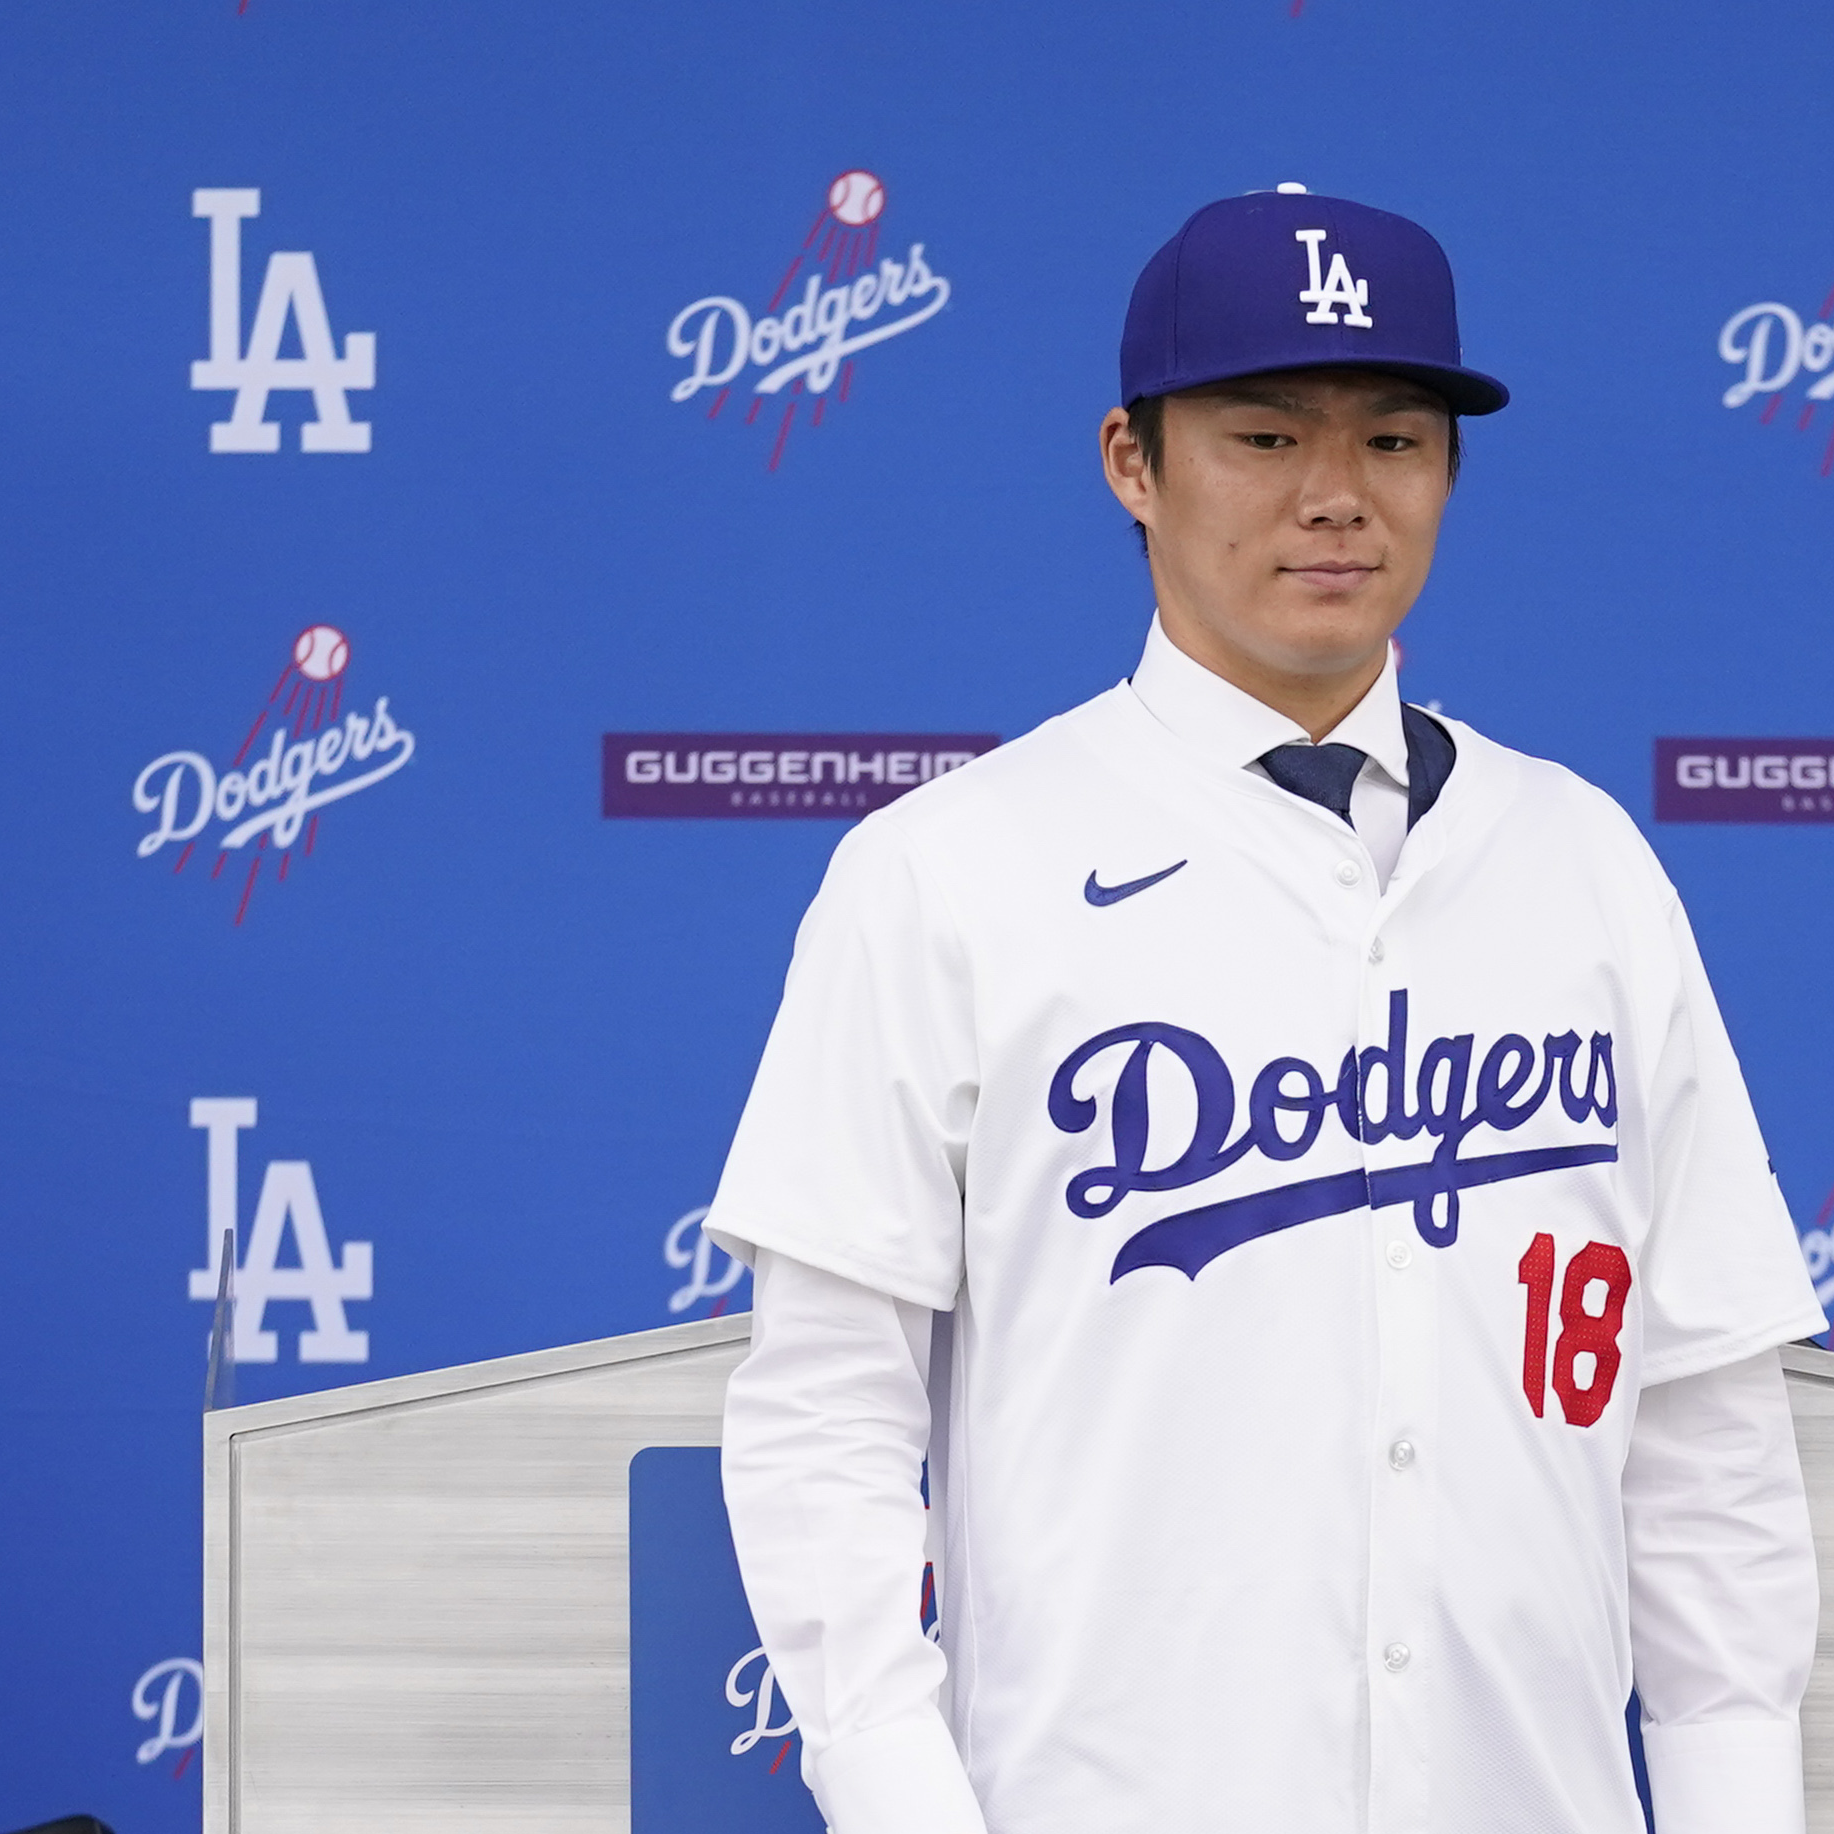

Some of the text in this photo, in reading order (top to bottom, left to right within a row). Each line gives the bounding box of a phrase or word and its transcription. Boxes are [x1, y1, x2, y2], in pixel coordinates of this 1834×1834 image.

[191, 189, 375, 453] LA
[668, 244, 949, 401] Dodgers
[1296, 230, 1372, 328] LA
[134, 698, 414, 856] Dodgers
[189, 1098, 372, 1362] LA
[1047, 989, 1619, 1285] Dodgers
[1516, 1231, 1635, 1428] 18
